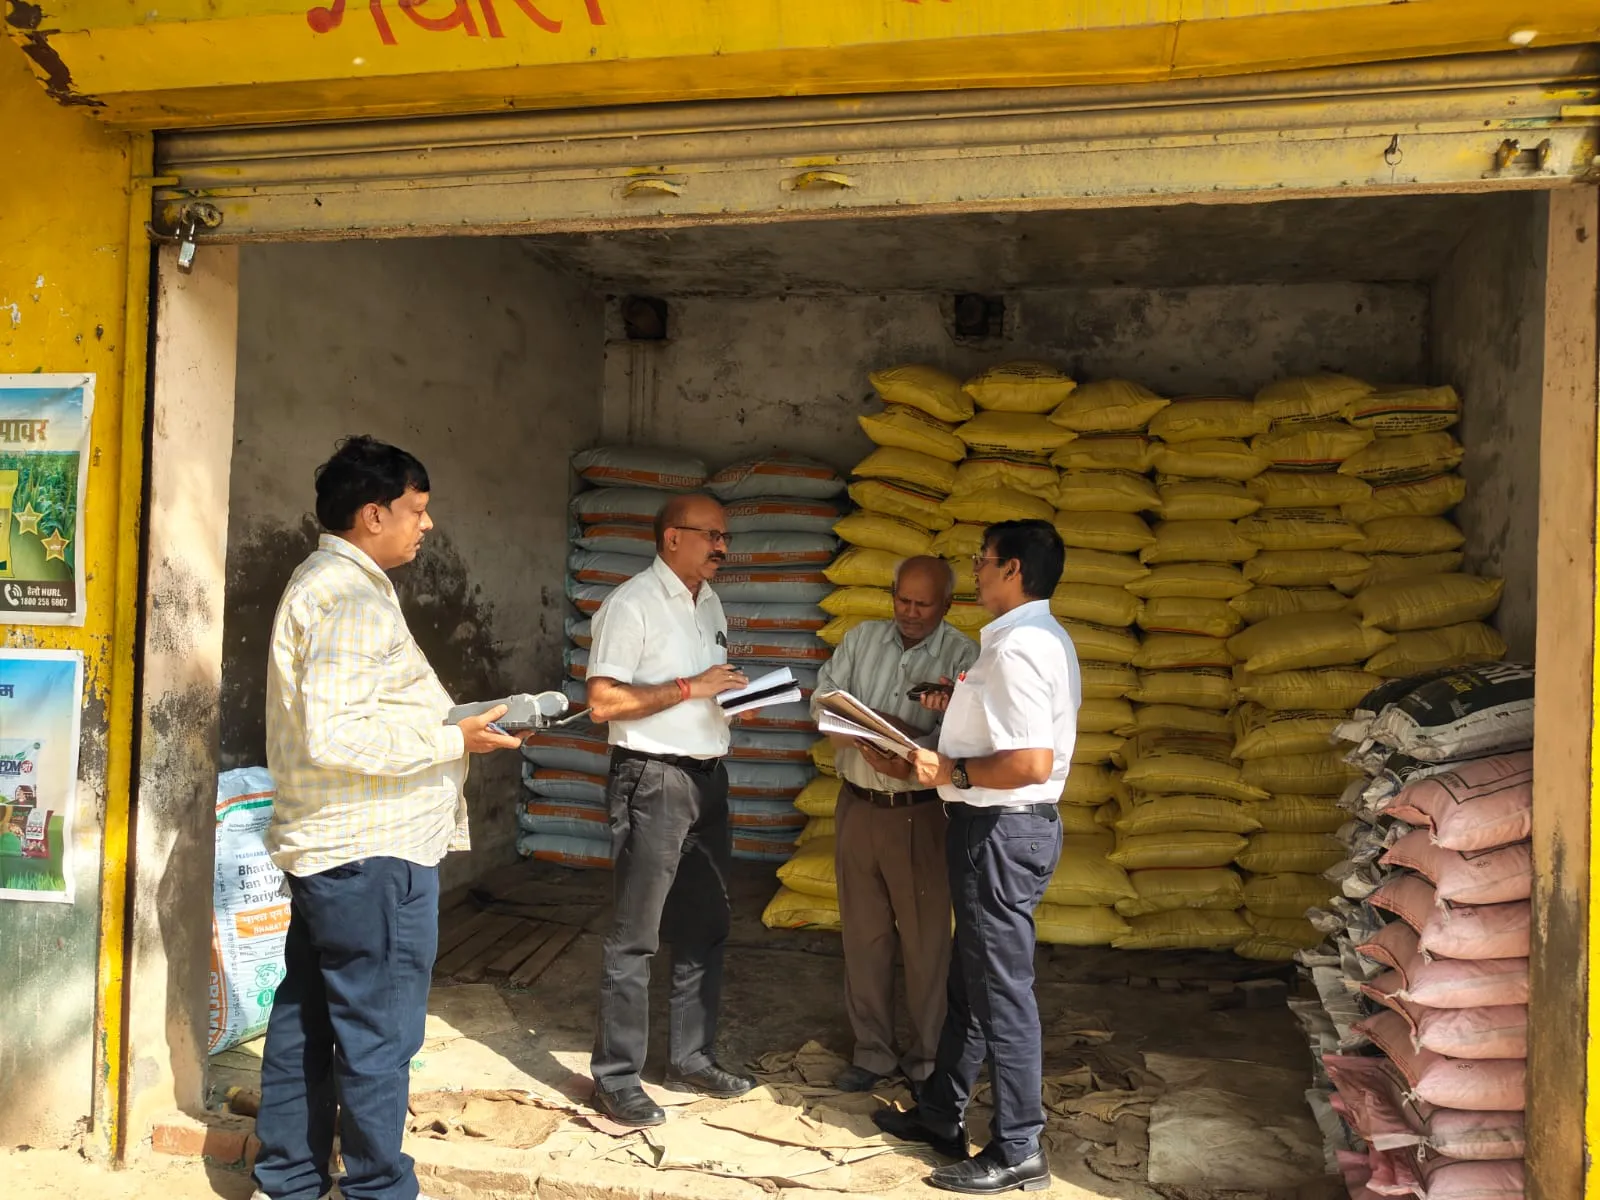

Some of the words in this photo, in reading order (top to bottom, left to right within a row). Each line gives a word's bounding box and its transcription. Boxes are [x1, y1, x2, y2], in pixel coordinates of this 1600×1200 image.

[41, 588, 62, 597] HURL
[20, 597, 36, 606] 1800
[238, 860, 279, 876] Bharti
[238, 879, 261, 890] Jan
